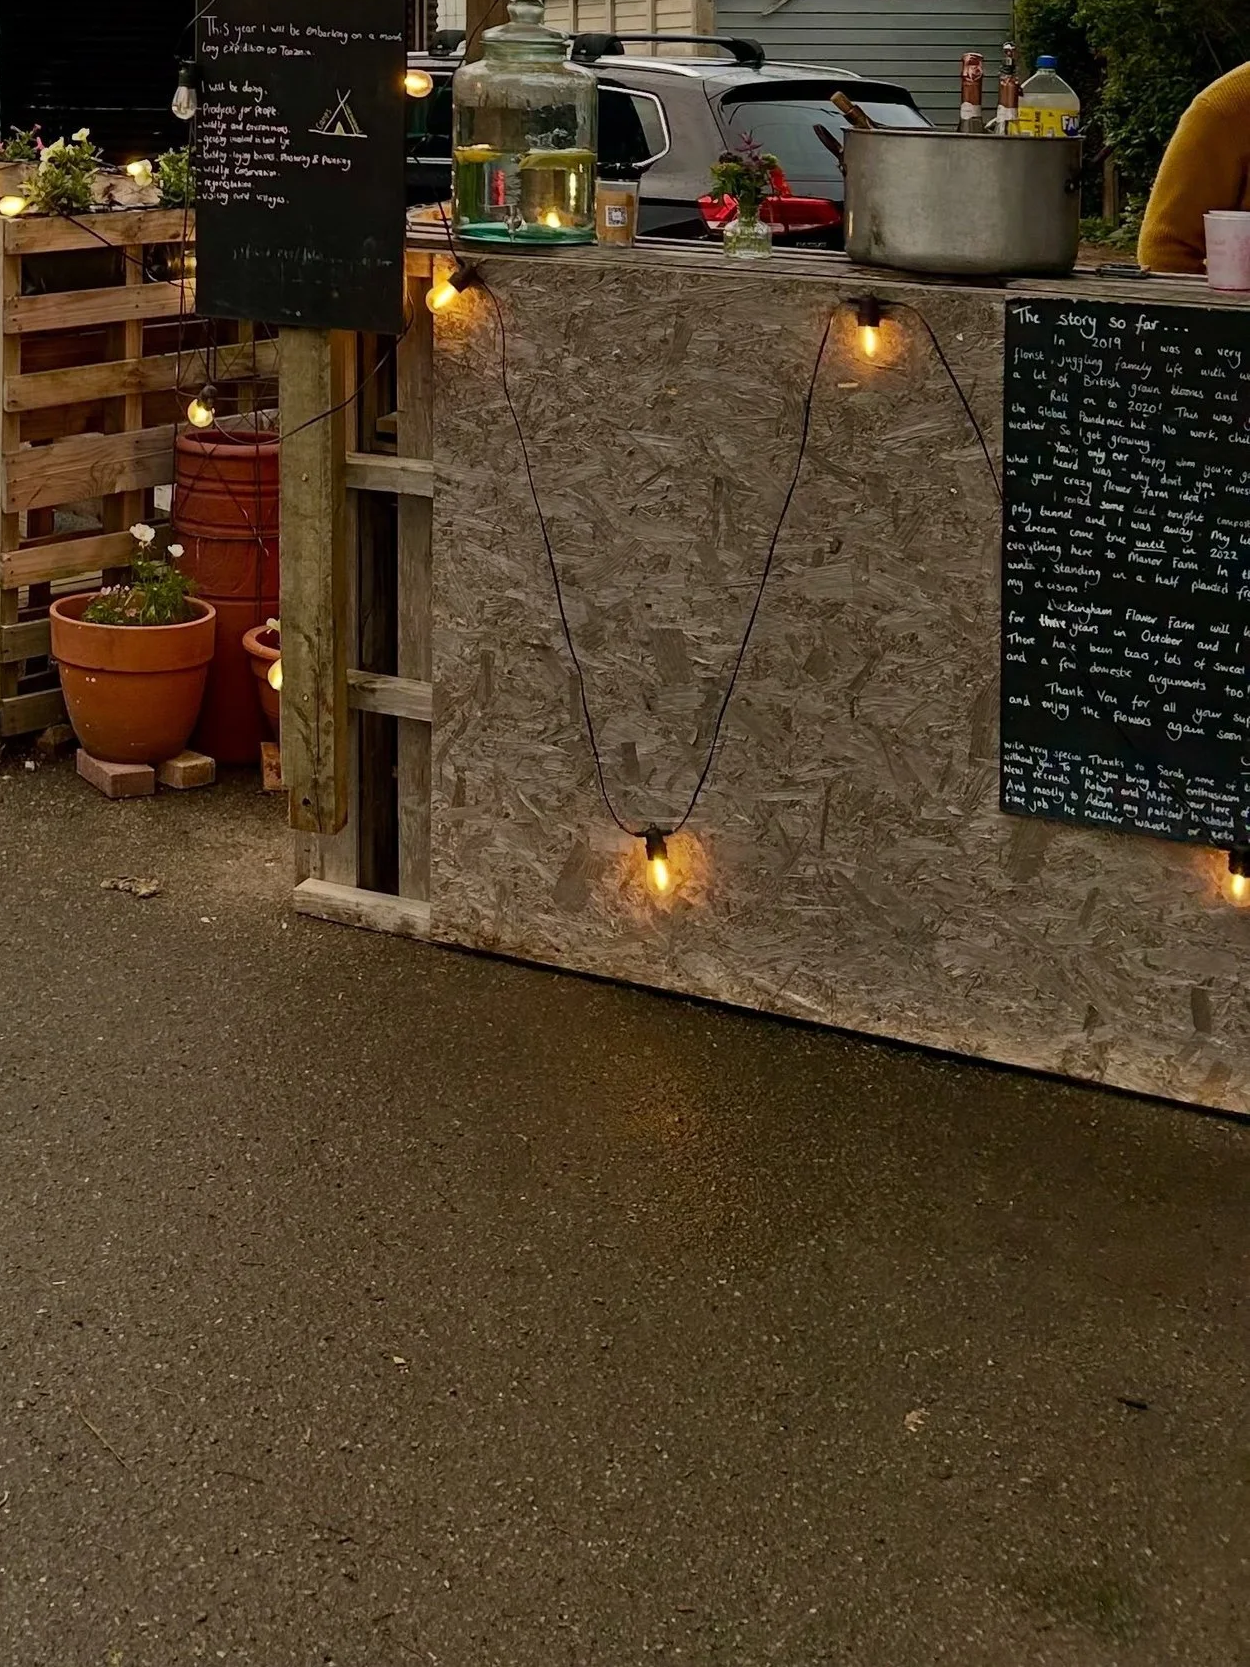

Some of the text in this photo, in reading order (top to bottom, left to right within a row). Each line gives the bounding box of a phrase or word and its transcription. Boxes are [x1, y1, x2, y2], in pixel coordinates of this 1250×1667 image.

[200, 15, 230, 36] This
[231, 24, 257, 45] year
[270, 24, 285, 33] will
[290, 23, 300, 36] be
[306, 26, 348, 45] embarking
[201, 41, 219, 60] long
[209, 80, 238, 92] will be
[230, 122, 243, 131] and
[311, 154, 319, 164] &
[1013, 306, 1040, 324] The
[1055, 313, 1096, 339] story
[1108, 317, 1126, 329] so
[1054, 334, 1241, 369] In 2019 was very
[1057, 354, 1225, 381] juggling family life with
[1059, 373, 1238, 401] of British grown and
[1012, 402, 1025, 413] the
[1038, 405, 1067, 419] Global
[1079, 410, 1124, 427] Pandemic
[1163, 425, 1176, 435] No
[1050, 390, 1069, 402] Roll
[1108, 398, 1117, 408] to
[1128, 401, 1162, 413] 2020!
[1175, 407, 1198, 419] This
[1213, 414, 1232, 424] was
[1060, 424, 1102, 445] So got
[1006, 453, 1029, 464] what
[1053, 456, 1078, 470] heard
[1093, 467, 1111, 477] was
[1193, 480, 1213, 494] you
[1088, 448, 1105, 465] only
[1112, 453, 1129, 461] ever
[1204, 465, 1232, 478] you're
[1031, 473, 1168, 500] your crazy flower farm
[1064, 495, 1091, 506] rented
[1099, 501, 1124, 511] some
[1012, 502, 1231, 550] poly tunnel and was My
[1025, 524, 1239, 560] dream come true until in 2022
[1006, 540, 1228, 577] everything here to Manor In
[1007, 579, 1023, 594] my
[1053, 563, 1101, 586] standing
[1155, 574, 1179, 588] half
[1192, 579, 1228, 594] planted
[1009, 611, 1025, 623] for
[1069, 622, 1099, 637] years
[1113, 627, 1127, 637] in
[1141, 630, 1182, 646] October
[1197, 641, 1219, 651] and
[1126, 609, 1230, 634] Flower Farm will
[1007, 632, 1035, 644] There
[1090, 643, 1112, 654] been
[1164, 652, 1181, 665] lots
[1194, 658, 1205, 670] of
[1213, 663, 1245, 674] sweat
[1006, 651, 1026, 663] and
[1059, 657, 1076, 672] few
[1090, 662, 1132, 677] domestic
[1148, 674, 1206, 694] arguments
[1009, 695, 1030, 706] and
[1042, 701, 1069, 720] enjoy
[1081, 706, 1100, 718] the
[1166, 722, 1205, 741] again
[1217, 730, 1241, 741] soon
[1045, 682, 1222, 724] Thank You for all your
[1029, 745, 1048, 761] very
[1088, 755, 1124, 768] Thanks
[1194, 776, 1215, 786] none
[1059, 762, 1071, 771] To
[1100, 770, 1119, 782] you
[1125, 773, 1150, 791] bring
[1186, 788, 1239, 802] enthusiasm
[1004, 765, 1231, 816] New recruits Robyn and love
[1006, 779, 1026, 792] And
[1032, 786, 1065, 804] mostly
[1070, 791, 1079, 800] to
[1123, 803, 1138, 818] my
[1004, 793, 1026, 806] time
[1029, 797, 1049, 813] job
[1064, 803, 1076, 815] he
[1084, 810, 1124, 824] neither
